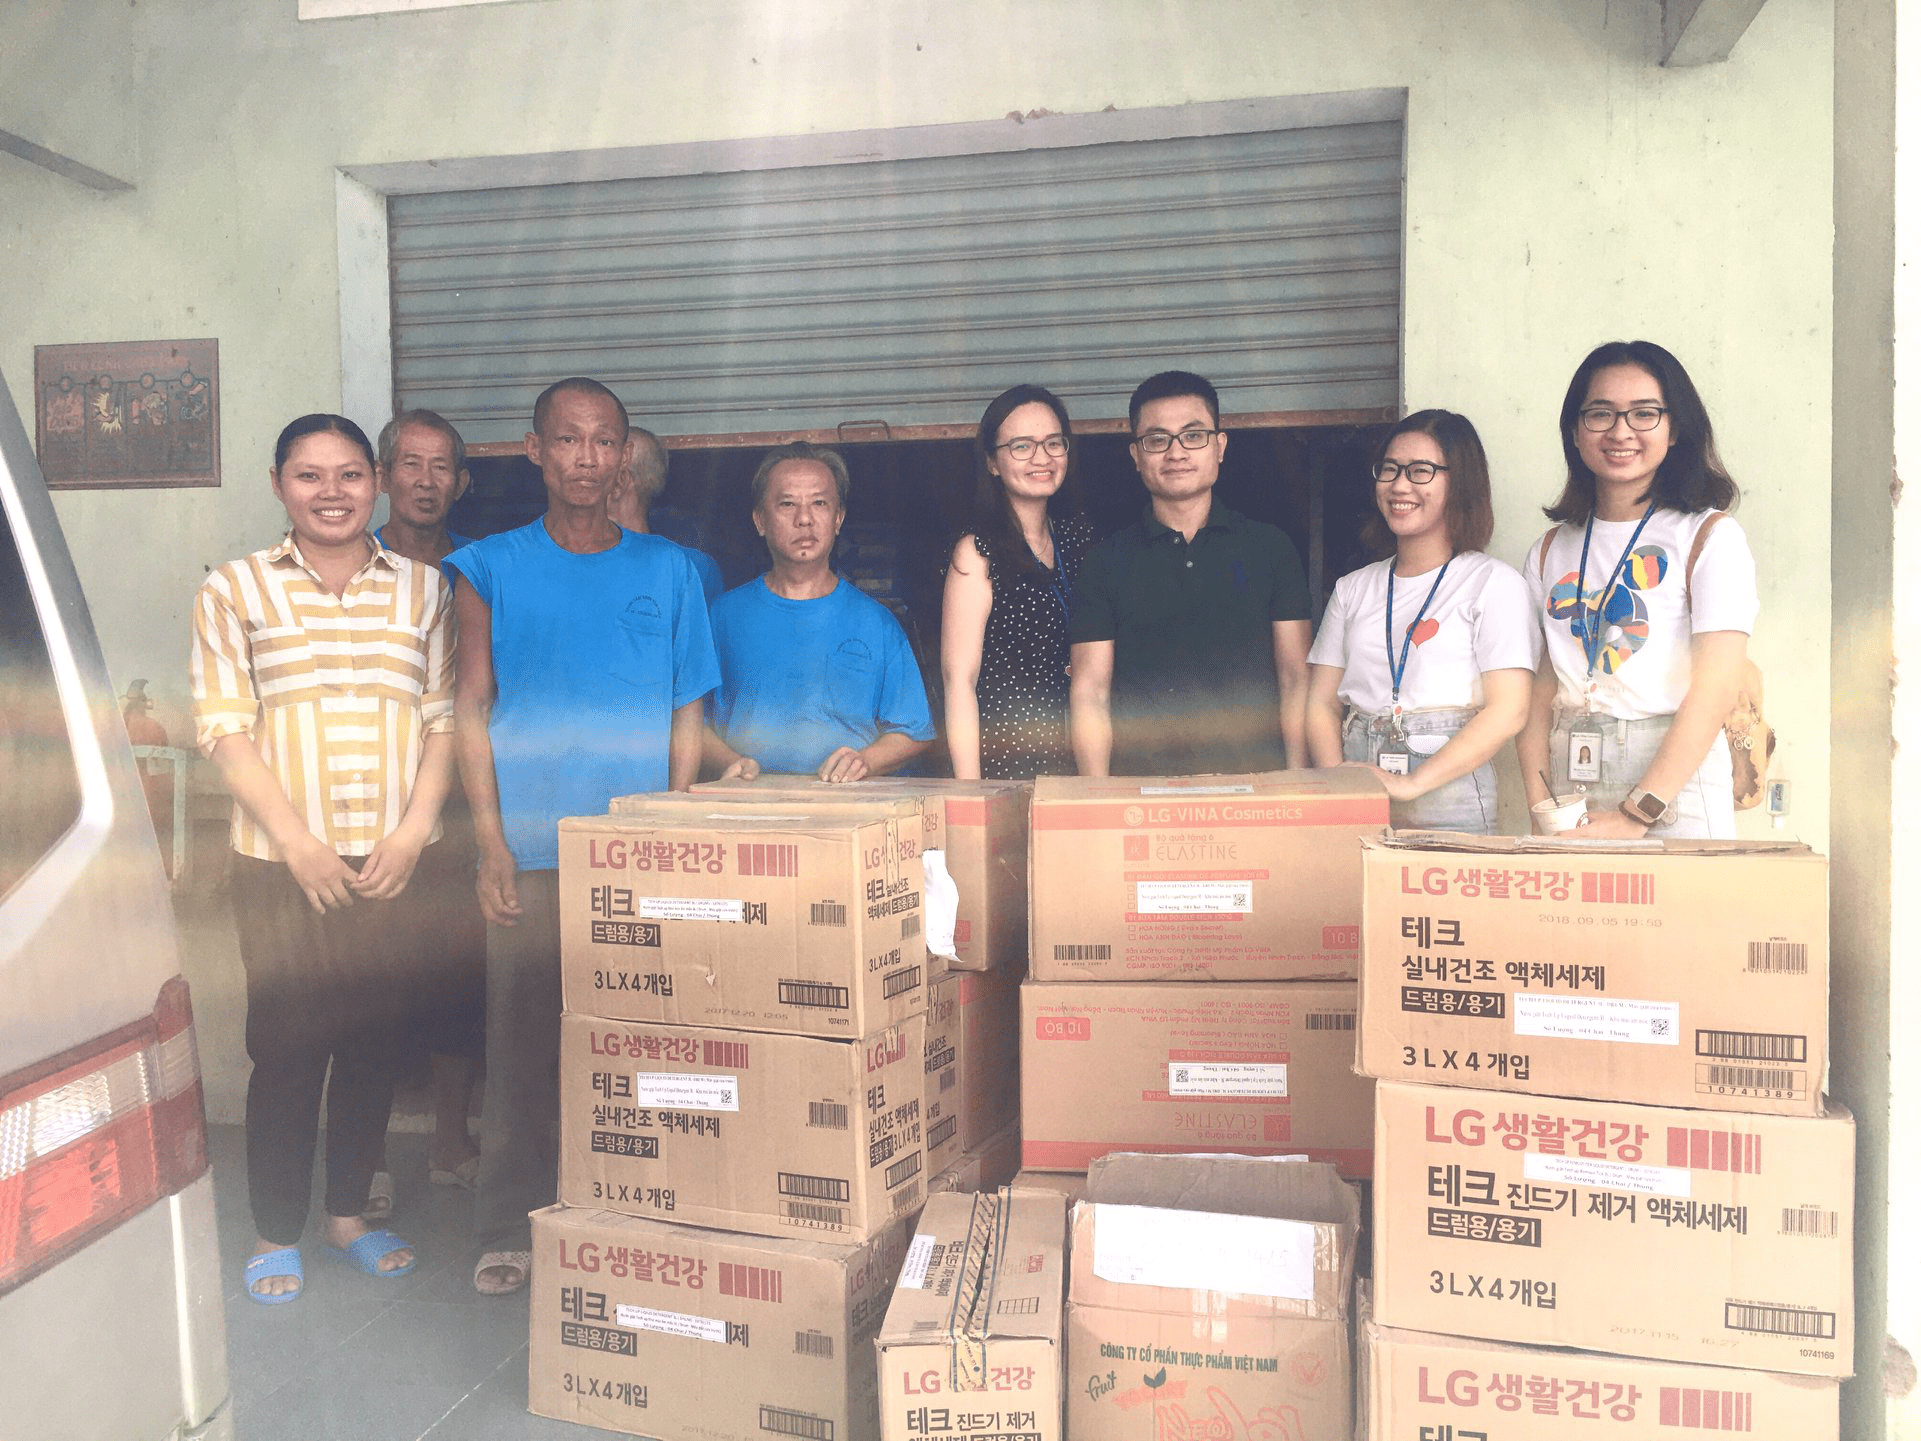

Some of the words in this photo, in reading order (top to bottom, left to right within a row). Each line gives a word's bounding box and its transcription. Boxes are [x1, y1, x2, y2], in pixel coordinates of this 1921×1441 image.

[1148, 808, 1171, 823] LG
[1176, 807, 1219, 822] VINA
[1222, 805, 1303, 821] Cosmetics
[1155, 844, 1238, 861] ELASTINE
[590, 884, 636, 919] 테크
[593, 923, 660, 946] 드럼용/용기
[1401, 916, 1465, 949] 테크
[1401, 954, 1498, 983] 실내건조
[1505, 960, 1606, 990] 액체세제
[1403, 988, 1503, 1016] 드럼용/용기
[1067, 1021, 1082, 1034] 10
[592, 1072, 633, 1100] 테크
[867, 1084, 886, 1115] 테크
[1707, 1085, 1795, 1099] 10741389
[592, 1104, 653, 1131] 실내건조
[658, 1111, 721, 1138] 액체세제
[593, 1132, 657, 1158] 드럼용/용기
[1427, 1164, 1500, 1207] 테크
[1505, 1181, 1577, 1218] 진드기
[1587, 1190, 1637, 1224] 제거
[1646, 1197, 1748, 1235] 액체세제
[788, 1217, 843, 1232] 10741389
[1430, 1210, 1539, 1246] 드럼용/용기
[560, 1286, 609, 1323] 테크
[562, 1325, 635, 1355] 드럼용/용기
[1799, 1348, 1835, 1360] 10741169
[1100, 1342, 1124, 1360] CÔNG
[1127, 1346, 1137, 1361] TY
[1234, 1354, 1254, 1374] VIỆT
[1256, 1358, 1278, 1373] NAM
[907, 1406, 953, 1435] 테크
[956, 1411, 1000, 1431] 진드기
[1006, 1410, 1036, 1430] 제거
